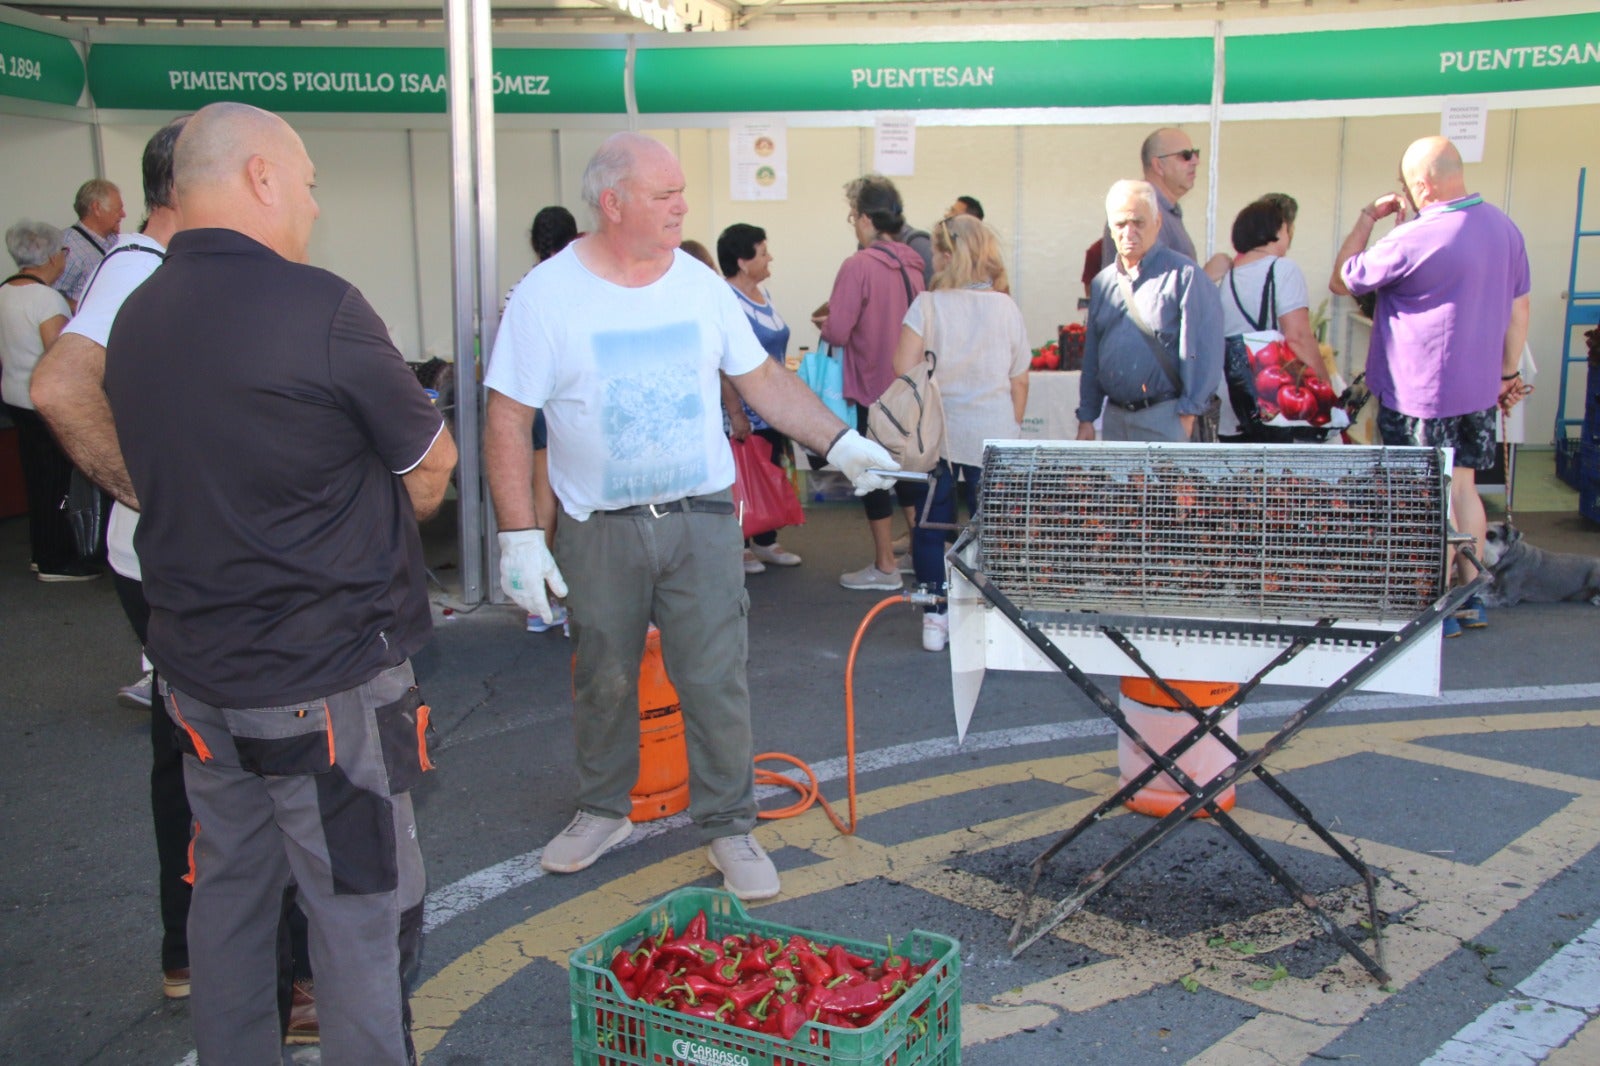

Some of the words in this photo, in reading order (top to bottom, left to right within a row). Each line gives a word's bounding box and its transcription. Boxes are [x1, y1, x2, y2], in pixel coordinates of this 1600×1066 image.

[9, 56, 41, 80] 1894
[1440, 44, 1600, 73] PUENTESAN
[169, 71, 288, 91] PIMIENTOS
[293, 72, 394, 92] PIQUILLO
[400, 74, 447, 93] ISAA
[492, 72, 550, 95] ÓMEZ
[851, 67, 994, 89] PUENTESAN
[690, 1043, 749, 1066] CARRASCO
